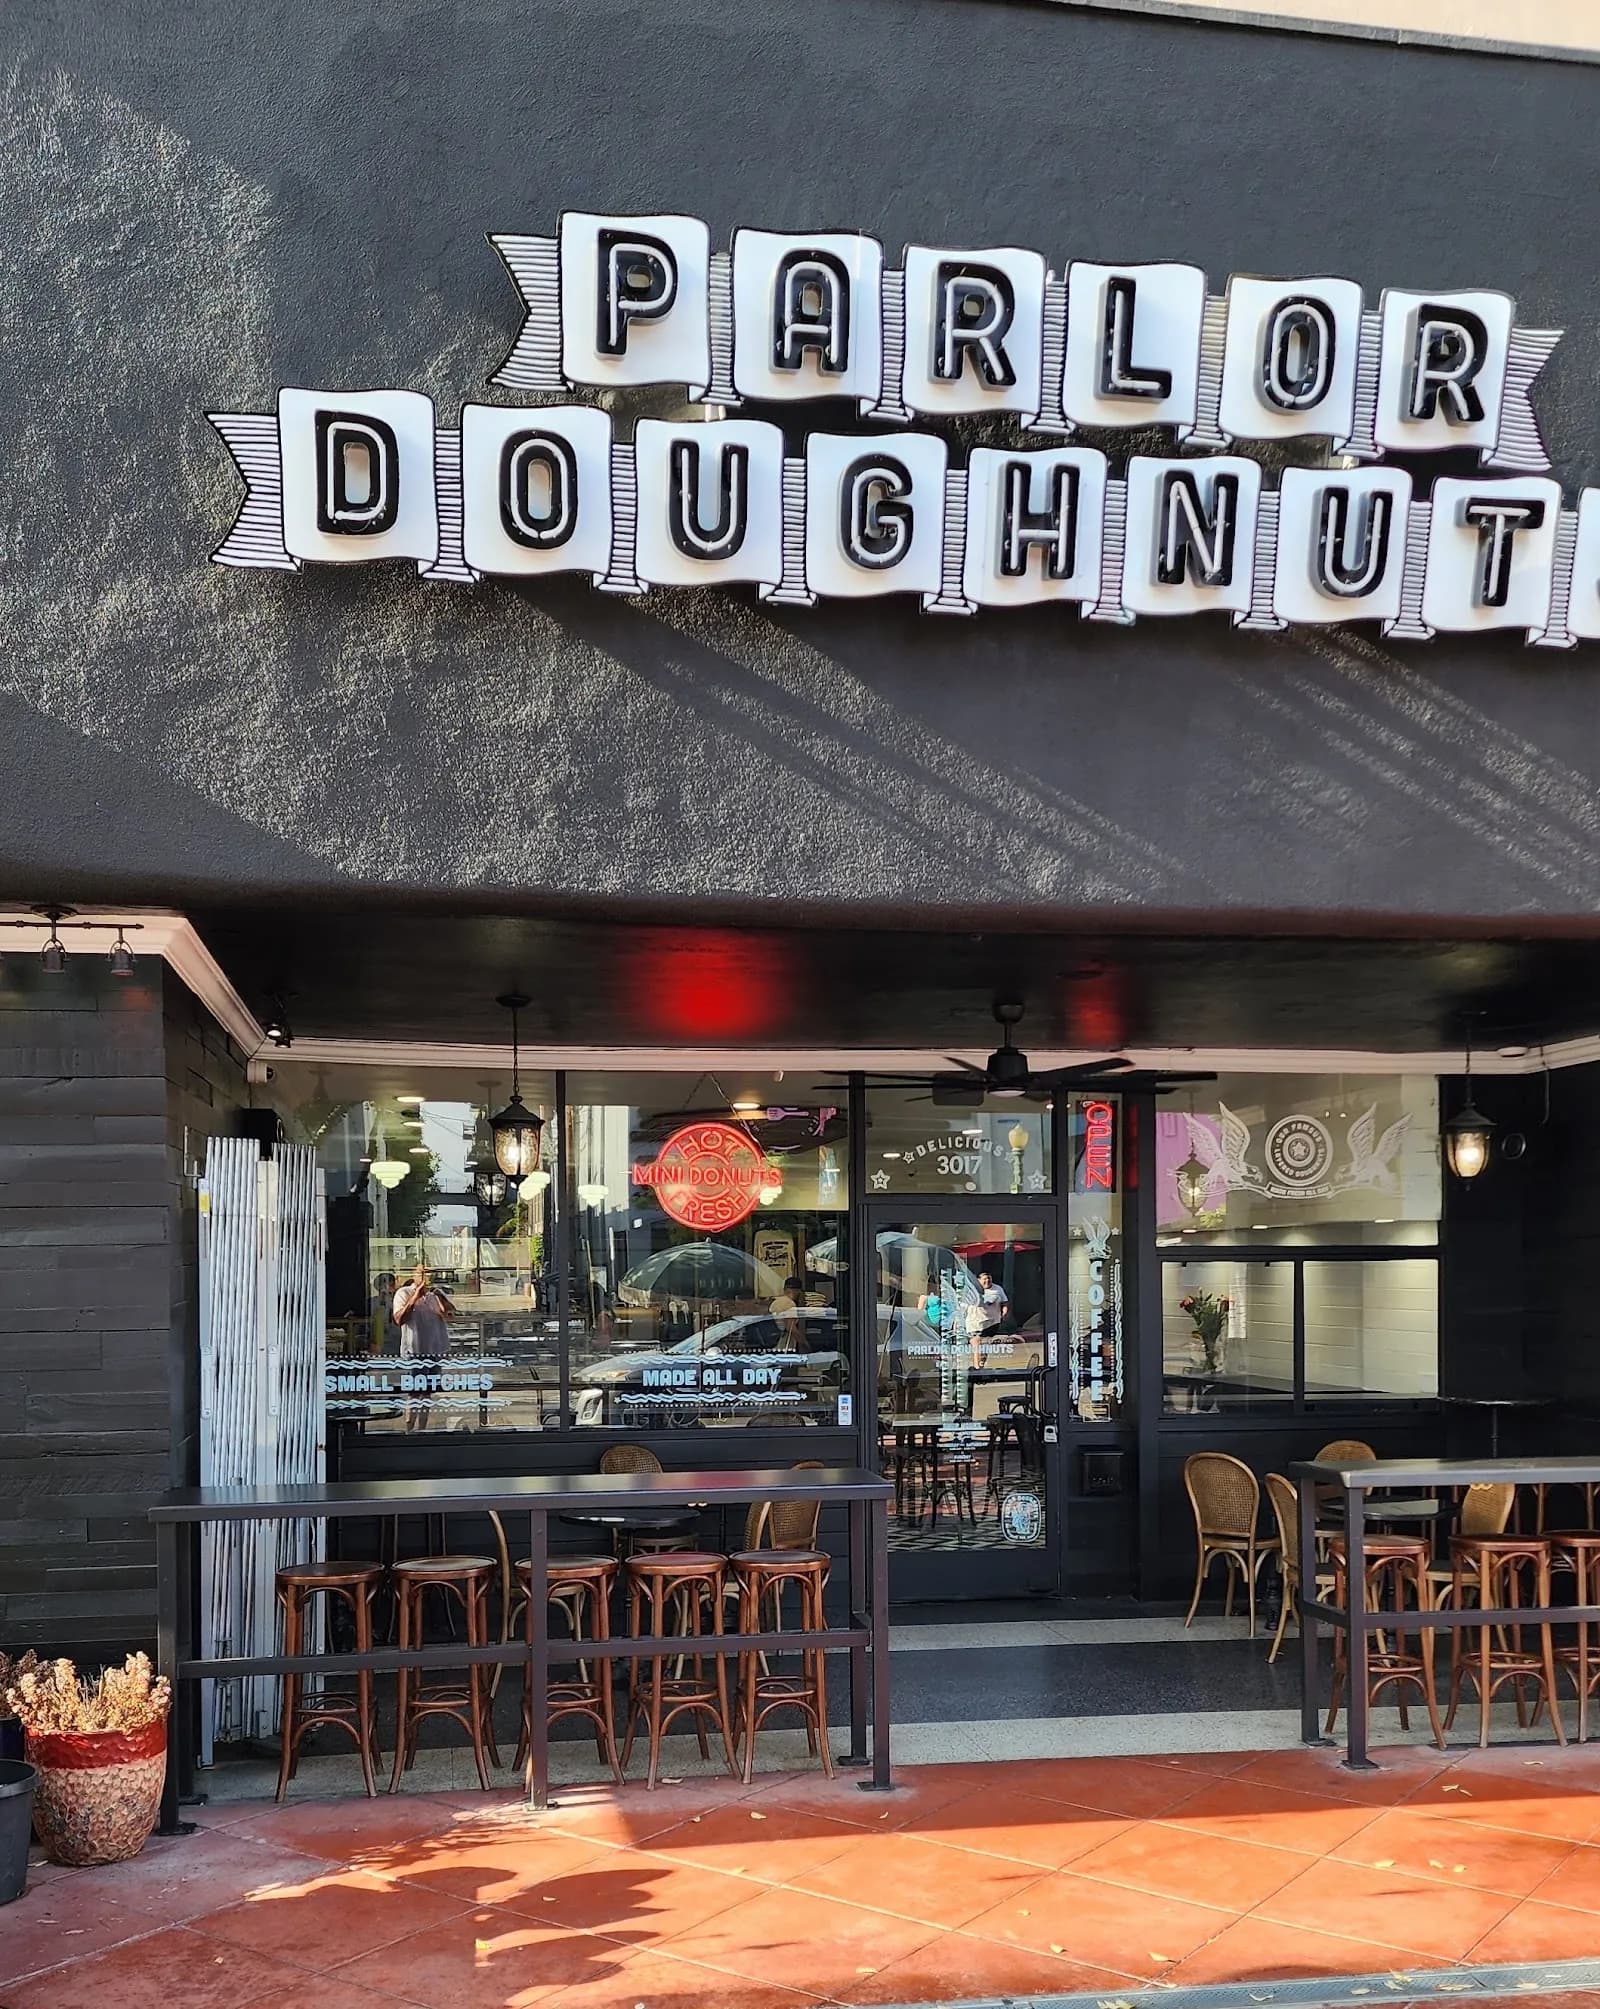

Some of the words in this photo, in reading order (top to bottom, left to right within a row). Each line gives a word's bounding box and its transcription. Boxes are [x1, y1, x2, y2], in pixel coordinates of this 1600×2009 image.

[595, 228, 1489, 423] PARLOR
[315, 409, 1600, 607] DOUGHNUT
[675, 1131, 744, 1160] HOT
[916, 1136, 1004, 1157] DELICIOUS
[1086, 1104, 1112, 1188] OPEN
[632, 1163, 682, 1185] MINI
[690, 1166, 783, 1186] DONUTS
[937, 1155, 982, 1175] 3017
[1088, 1260, 1104, 1401] COFFEE
[907, 1344, 948, 1355] PARLOR
[325, 1375, 393, 1392] SMALL
[401, 1373, 494, 1391] BATCHES
[643, 1369, 697, 1386] MADE
[703, 1370, 737, 1385] ALL
[743, 1369, 781, 1385] DAY
